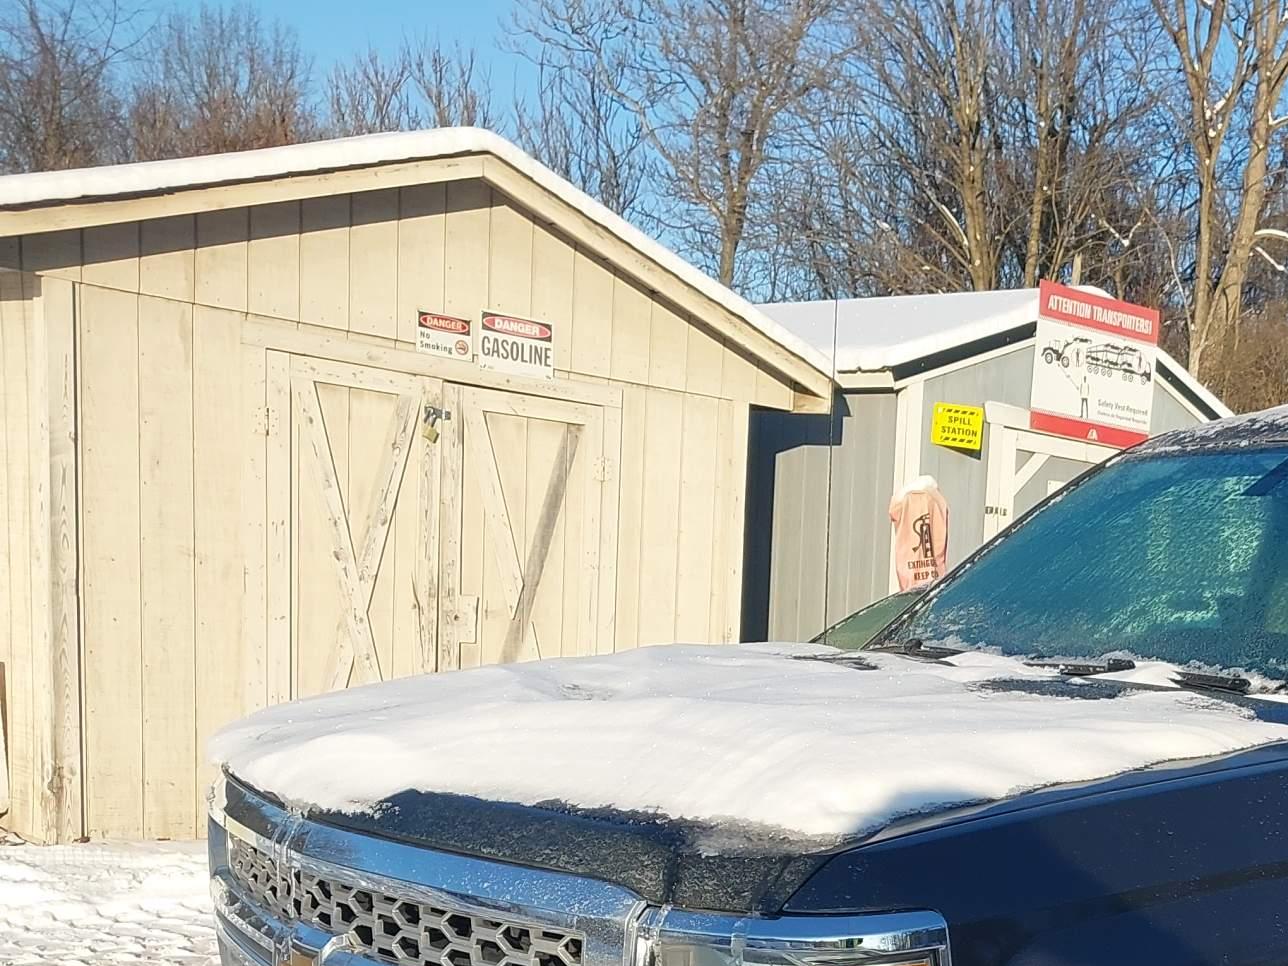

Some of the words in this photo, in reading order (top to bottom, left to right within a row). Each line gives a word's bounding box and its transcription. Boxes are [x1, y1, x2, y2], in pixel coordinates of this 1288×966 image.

[1048, 294, 1092, 319] ATTENTION
[1092, 306, 1153, 335] TRANSPORTERS!
[425, 316, 463, 331] DANGER
[494, 318, 540, 336] DANGER
[419, 329, 431, 340] No
[419, 340, 453, 355] Smoking
[481, 335, 552, 368] GASOLINE
[947, 414, 973, 427] SPILL
[940, 424, 978, 438] STATION
